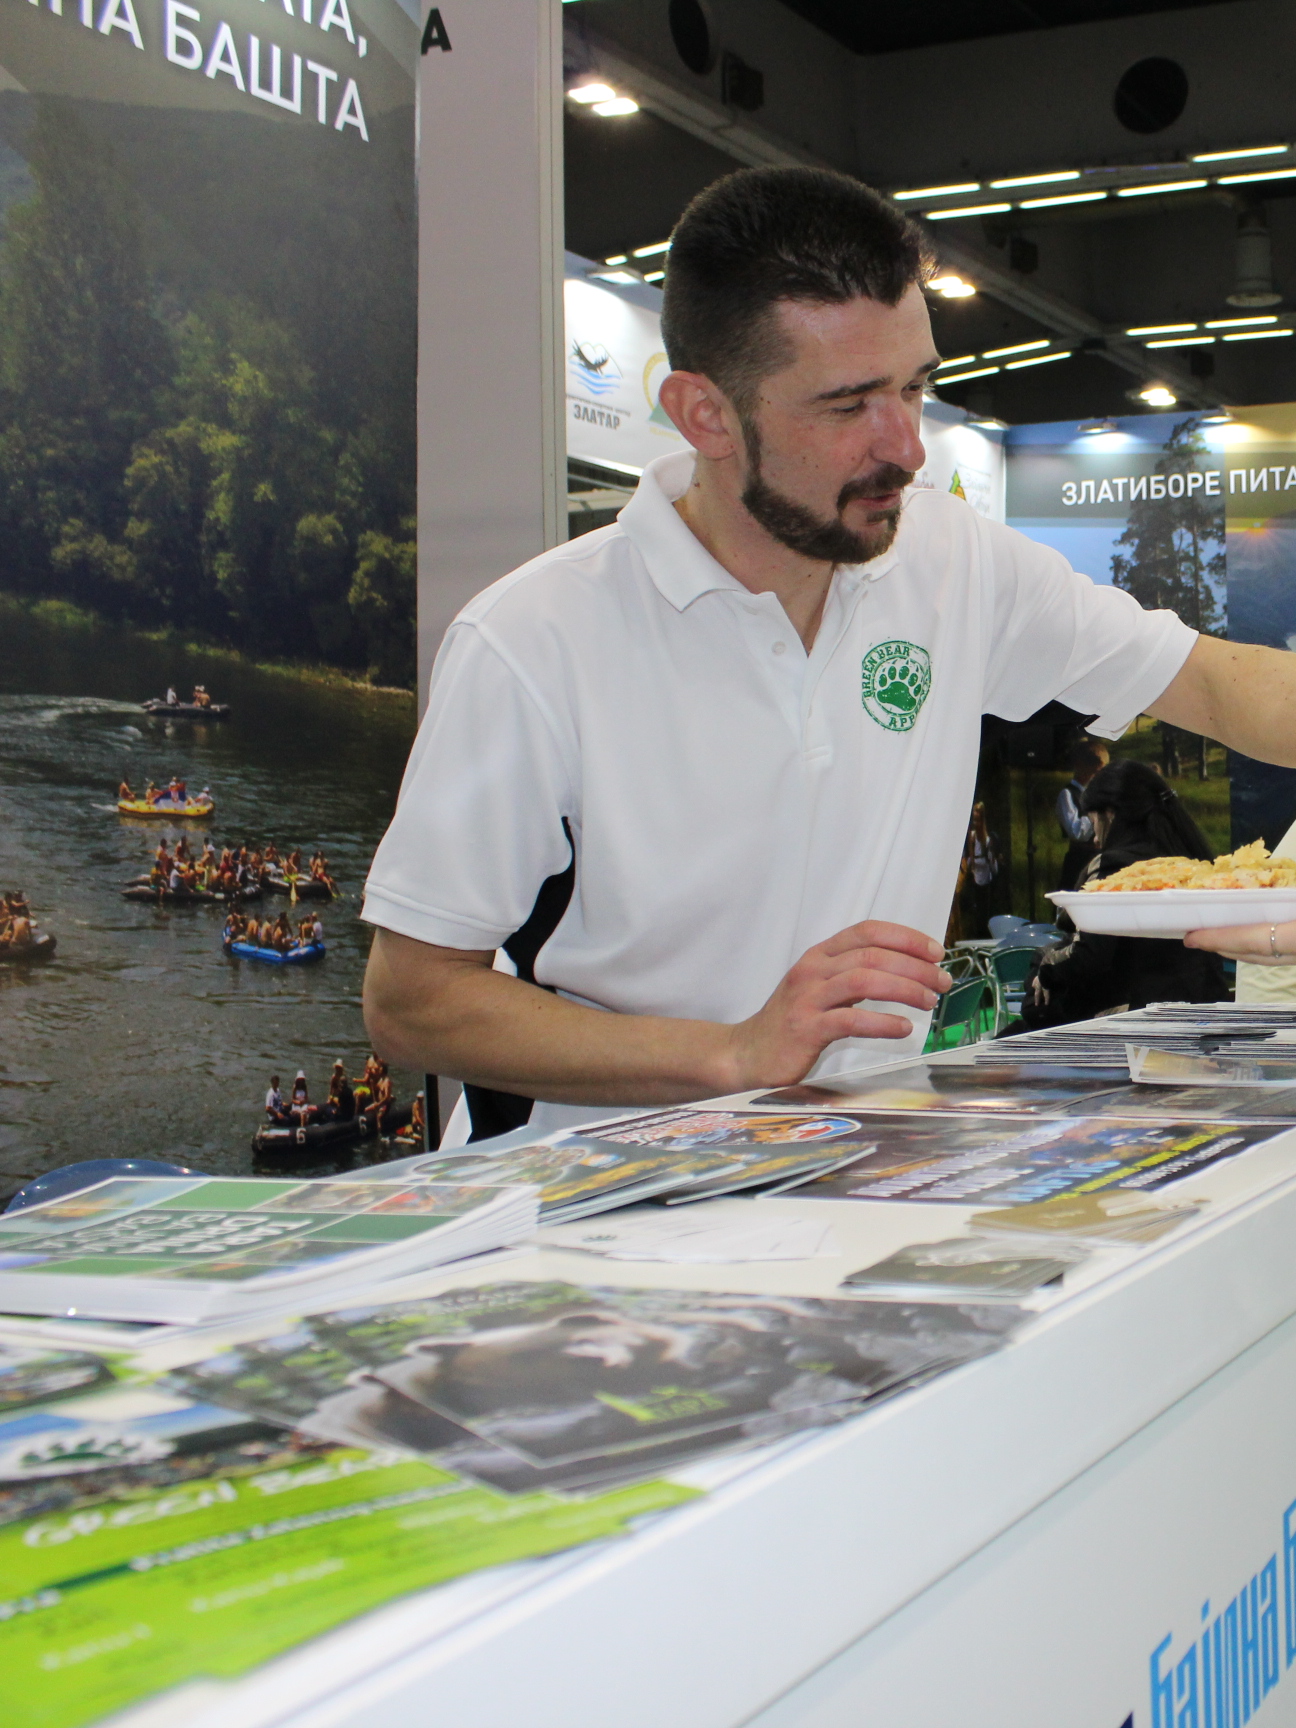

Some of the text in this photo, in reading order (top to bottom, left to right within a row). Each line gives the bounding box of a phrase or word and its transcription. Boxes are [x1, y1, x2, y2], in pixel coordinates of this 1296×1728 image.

[166, 0, 369, 143] БАШТА
[573, 404, 621, 430] ЗЛАТАР
[1061, 470, 1221, 506] ЗЛАТИБОРЕ
[862, 645, 911, 698] GREEN BEAR
